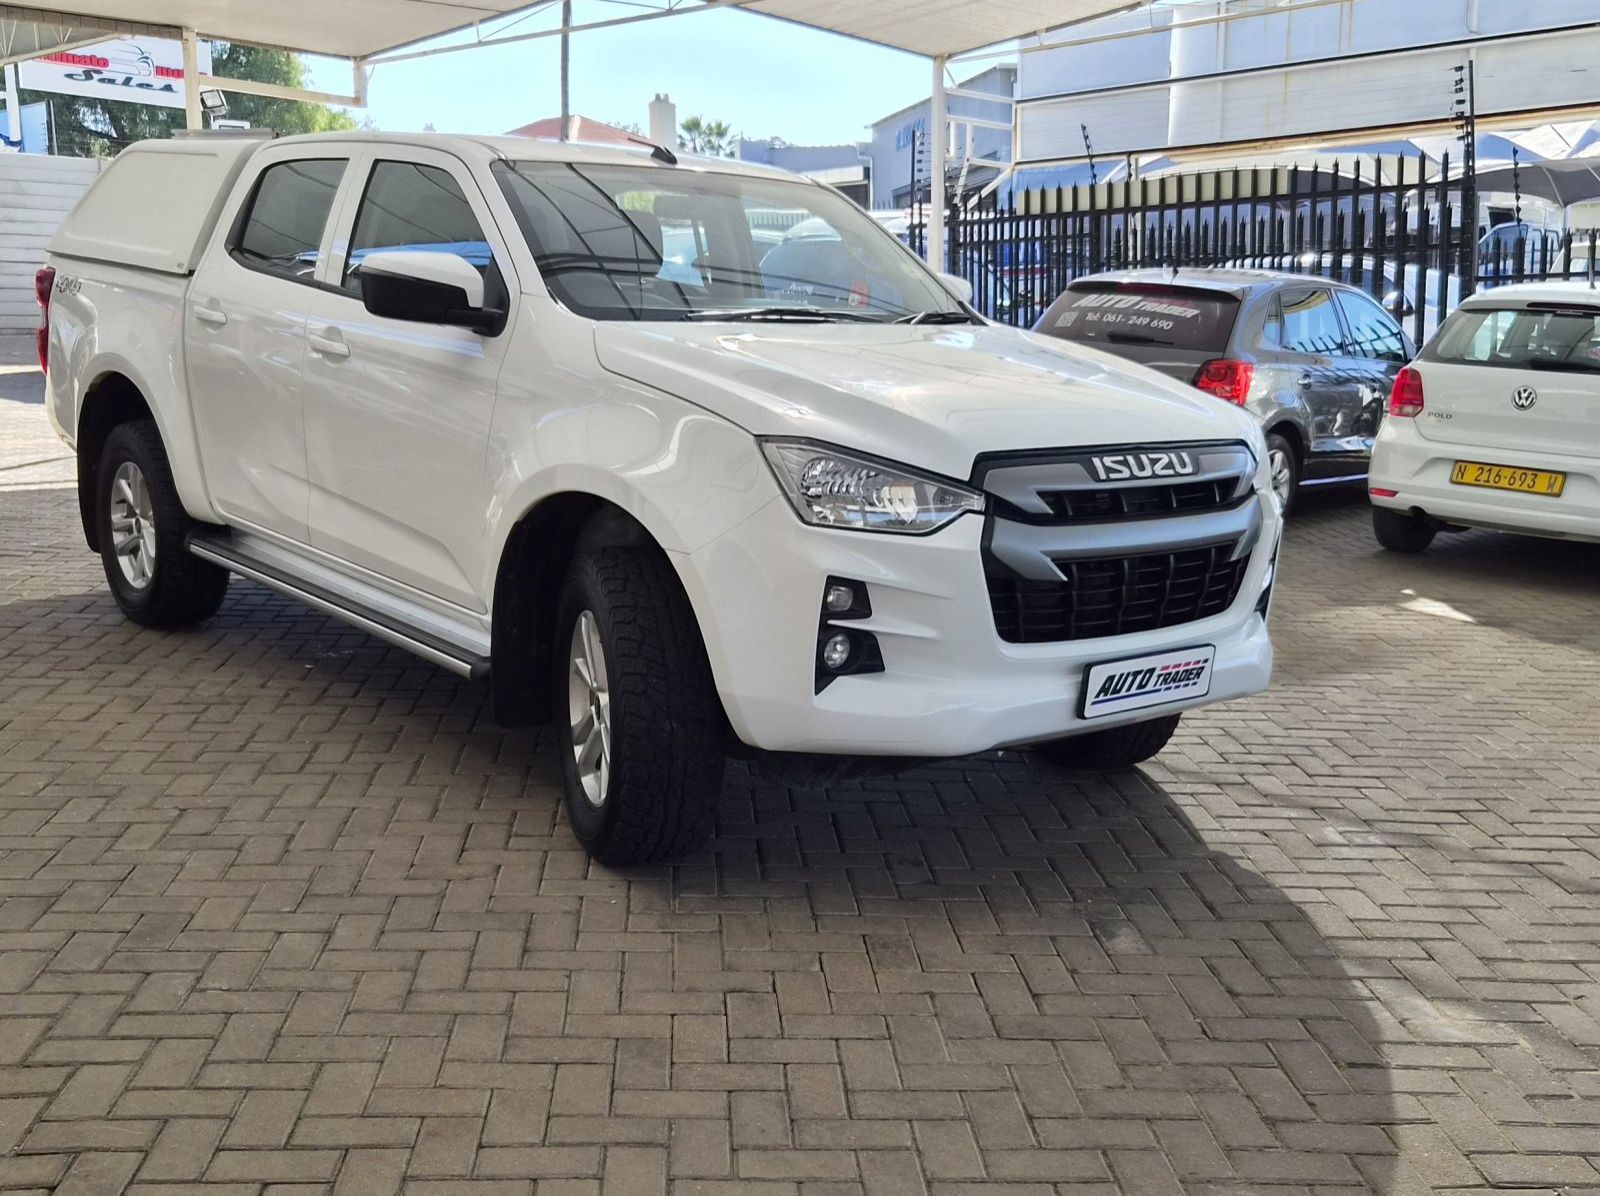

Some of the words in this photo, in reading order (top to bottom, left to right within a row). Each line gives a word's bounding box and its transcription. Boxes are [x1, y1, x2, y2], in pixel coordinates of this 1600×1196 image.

[64, 69, 177, 93] Sales
[1072, 295, 1143, 308] AUTO
[1134, 302, 1200, 317] TRADER
[1085, 312, 1101, 321] Tel:
[1127, 315, 1149, 326] 249
[1150, 320, 1174, 330] 690
[1427, 411, 1453, 420] POLO
[1091, 452, 1193, 480] ISUZU
[1456, 464, 1468, 481] N
[1094, 667, 1156, 699] AUTO
[1153, 666, 1205, 688] TRADER
